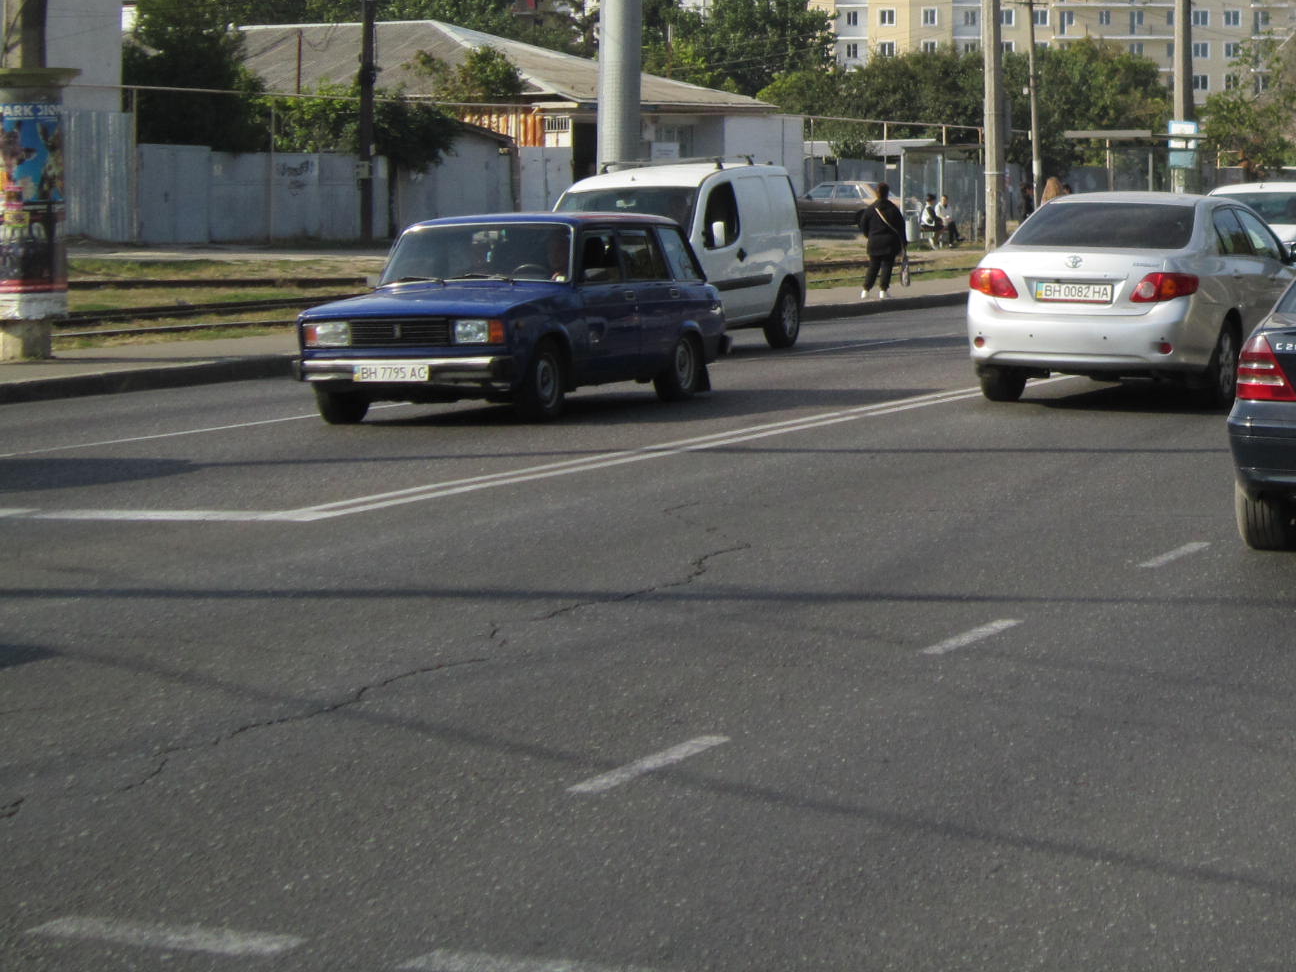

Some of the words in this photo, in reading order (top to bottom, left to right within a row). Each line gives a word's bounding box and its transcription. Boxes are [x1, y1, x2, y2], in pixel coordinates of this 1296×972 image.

[1044, 285, 1062, 297] BH
[1063, 285, 1090, 298] 0082
[1092, 286, 1109, 298] HA
[1275, 342, 1283, 350] C
[361, 367, 377, 379] BH
[380, 367, 406, 379] 7795
[410, 366, 426, 378] AC
